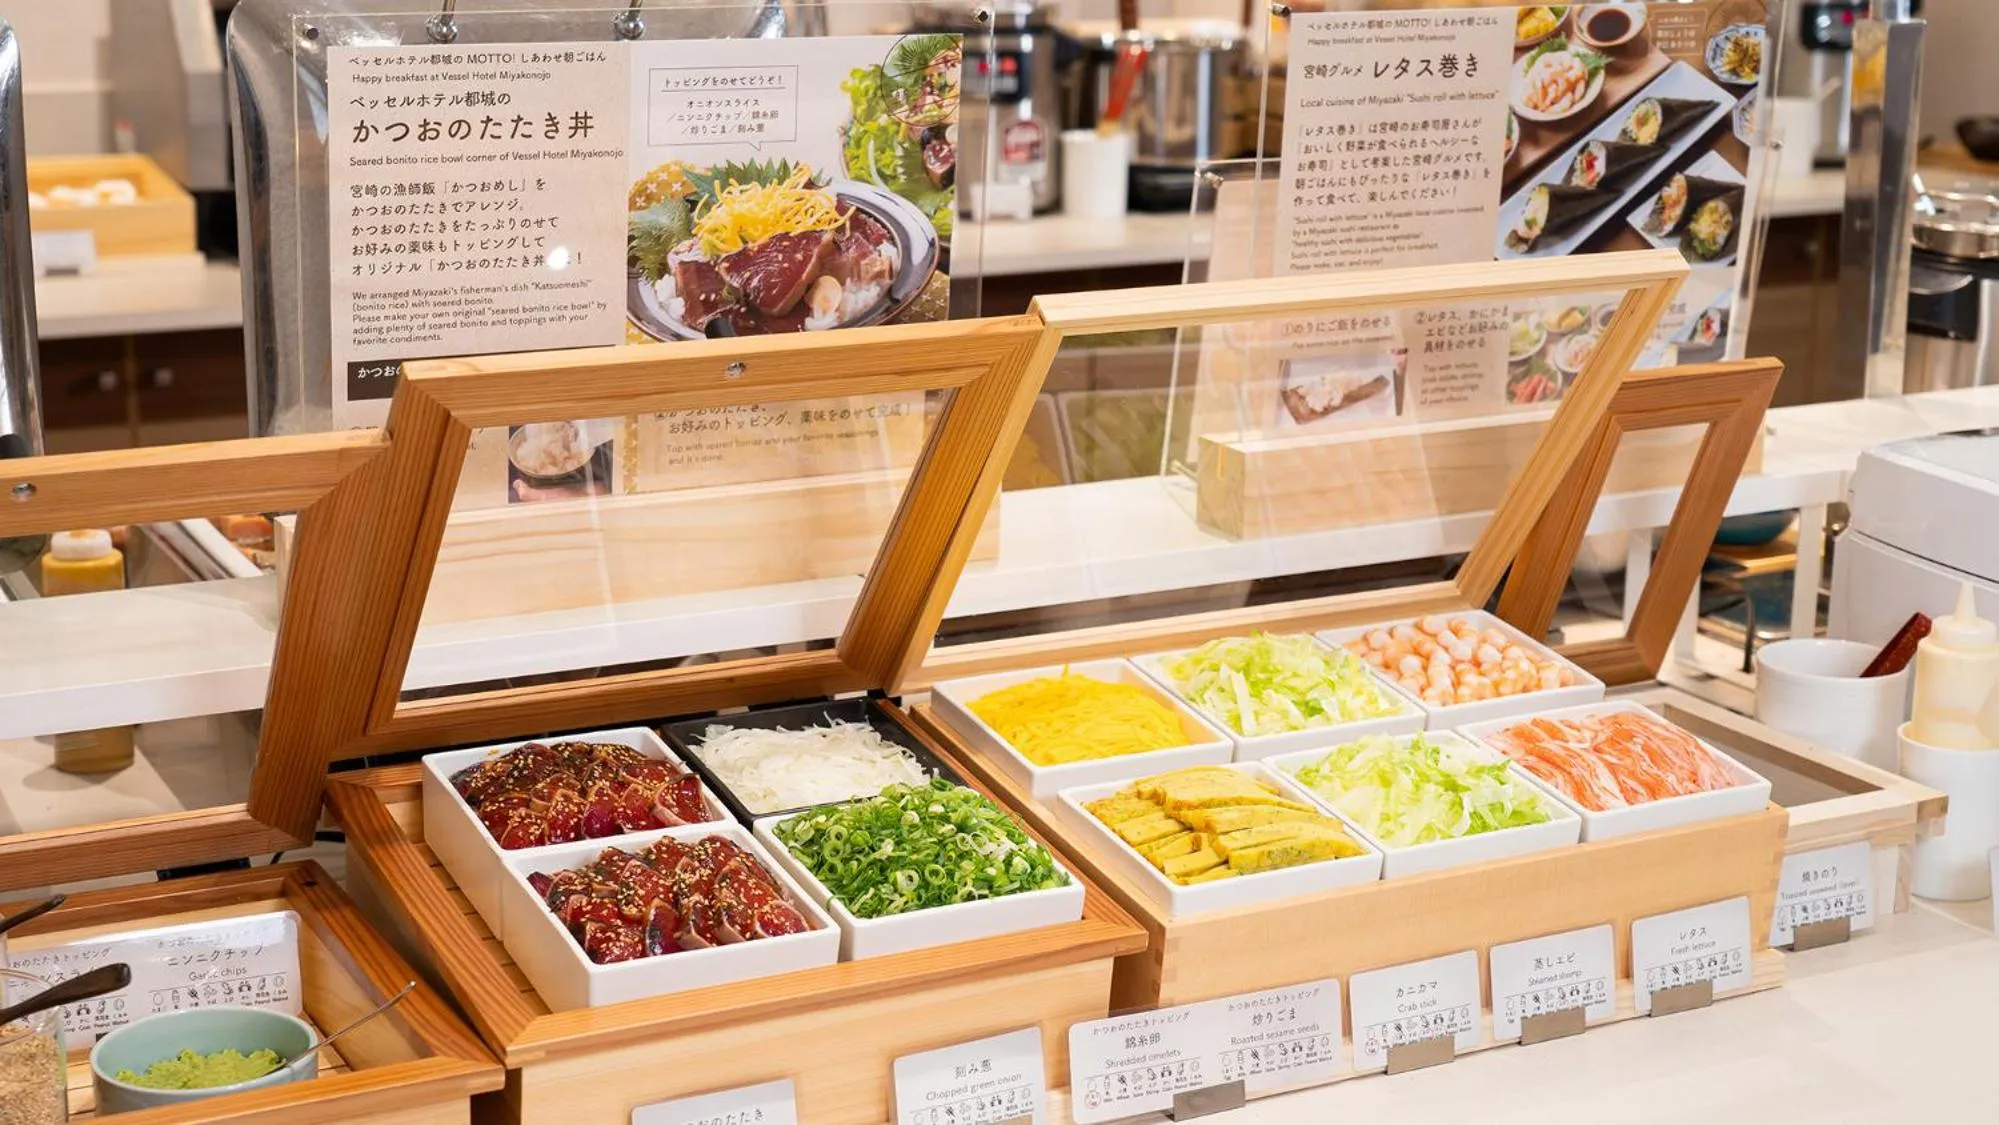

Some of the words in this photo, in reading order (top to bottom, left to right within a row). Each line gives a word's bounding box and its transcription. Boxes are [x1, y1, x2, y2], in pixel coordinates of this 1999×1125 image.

[350, 52, 463, 66] ベッセルホテル都城の
[467, 53, 516, 64] MOTTO!
[521, 51, 606, 63] しあわせ朝ごはん
[1303, 62, 1363, 80] 宮崎グルメ
[1373, 53, 1479, 80] レタス巻き
[352, 74, 382, 83] Happy
[385, 73, 427, 82] breakfast
[441, 72, 469, 81] Vessel
[472, 71, 496, 80] Hotel
[499, 71, 551, 81] Miyakonojo
[350, 91, 511, 108] ベッセルホテル都城の
[687, 98, 761, 108] オニオンスライス
[1300, 97, 1324, 108] Local
[1326, 97, 1354, 107] cuisine
[1357, 97, 1366, 106] of
[1368, 94, 1403, 107] Miyazaki
[1433, 92, 1447, 101] roll
[1449, 91, 1466, 100] with
[352, 110, 594, 143] かつおのたたき丼
[350, 156, 383, 166] Seared
[386, 155, 418, 165] bonito
[421, 155, 438, 164] rice
[441, 153, 463, 163] bowl
[466, 153, 496, 162] corner
[499, 152, 510, 161] of
[512, 151, 540, 160] Vessel
[543, 150, 567, 159] Hotel
[570, 148, 624, 160] Miyakonojo
[352, 198, 524, 217] かつおのたたきでアレンジ。
[352, 216, 559, 237] かつおのたたきをたっぷりのせて
[352, 235, 545, 257] お好みの薬味もトッピングして
[352, 291, 367, 300] We
[369, 290, 410, 301] arranged
[412, 287, 457, 298] Miyazaki's
[460, 284, 508, 295] fisherman's
[511, 283, 529, 292] dish
[352, 313, 380, 323] Please
[384, 311, 407, 321] make
[410, 311, 429, 322] your
[432, 310, 450, 318] own
[453, 307, 485, 319] original
[522, 304, 550, 314] bonito
[553, 303, 568, 312] rice
[597, 302, 607, 312] by
[353, 301, 386, 312] (bonito
[389, 300, 409, 310] rice)
[411, 299, 430, 308] with
[432, 297, 462, 307] seared
[465, 296, 493, 306] bonito.
[353, 324, 384, 336] adding
[387, 322, 414, 335] plenty
[417, 321, 426, 331] of
[429, 320, 457, 330] seared
[460, 318, 488, 329] bonito
[491, 317, 507, 327] and
[510, 316, 546, 328] toppings
[549, 313, 567, 323] with
[570, 313, 588, 324] your
[353, 335, 388, 346] favorite
[390, 332, 443, 345] condiments.
[1679, 927, 1707, 940] レタス
[1692, 939, 1716, 951] lettuce
[221, 967, 247, 977] chips
[1396, 981, 1438, 998] カニカマ
[1398, 1002, 1417, 1013] Crab
[1420, 999, 1437, 1009] stick
[1253, 1008, 1297, 1026] 炒りごま
[1231, 1033, 1264, 1046] Roasted
[1266, 1027, 1296, 1041] sesame
[1105, 1054, 1147, 1070] Shredded
[926, 1081, 967, 1102] Chopped
[970, 1078, 995, 1095] green
[997, 1072, 1022, 1086] onion
